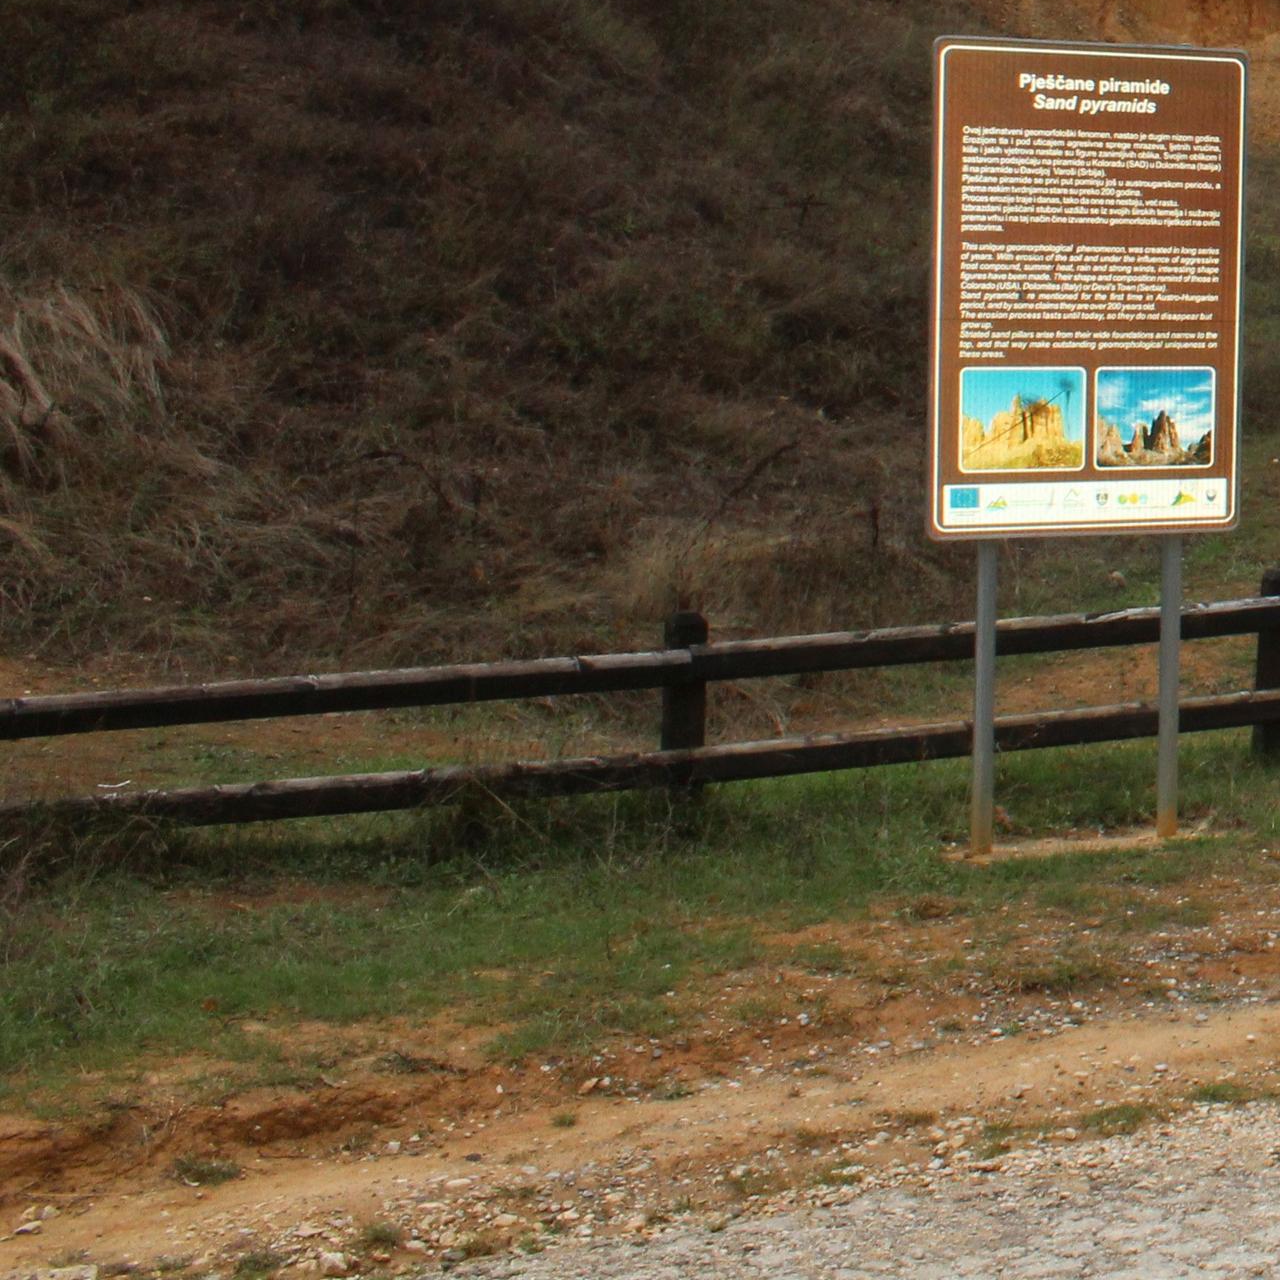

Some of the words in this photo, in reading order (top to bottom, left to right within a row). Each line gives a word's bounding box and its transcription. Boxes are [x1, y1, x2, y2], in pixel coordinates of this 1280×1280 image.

[1019, 73, 1094, 93] Pješčane
[1099, 77, 1170, 95] piramide
[1033, 94, 1077, 110] Sand
[1079, 98, 1156, 115] pyramids
[962, 126, 981, 136] Ovaj
[1172, 133, 1194, 141] nizom
[1016, 137, 1031, 147] pod
[1053, 158, 1085, 168] piramide
[1092, 158, 1125, 167] Koloradu
[1126, 160, 1149, 169] (SAD)
[999, 176, 1032, 186] piramide
[1060, 177, 1073, 187] put
[1181, 246, 1197, 255] long
[1123, 254, 1136, 262] the
[960, 281, 996, 289] Colorado
[1081, 292, 1092, 300] for
[1094, 292, 1107, 300] the
[987, 301, 1002, 309] and
[961, 310, 976, 318] The
[1009, 312, 1041, 320] process
[1043, 311, 1062, 319] lasts
[1063, 311, 1081, 319] until
[1082, 311, 1105, 320] today,
[1118, 312, 1135, 321] they
[1161, 312, 1199, 321] disappear
